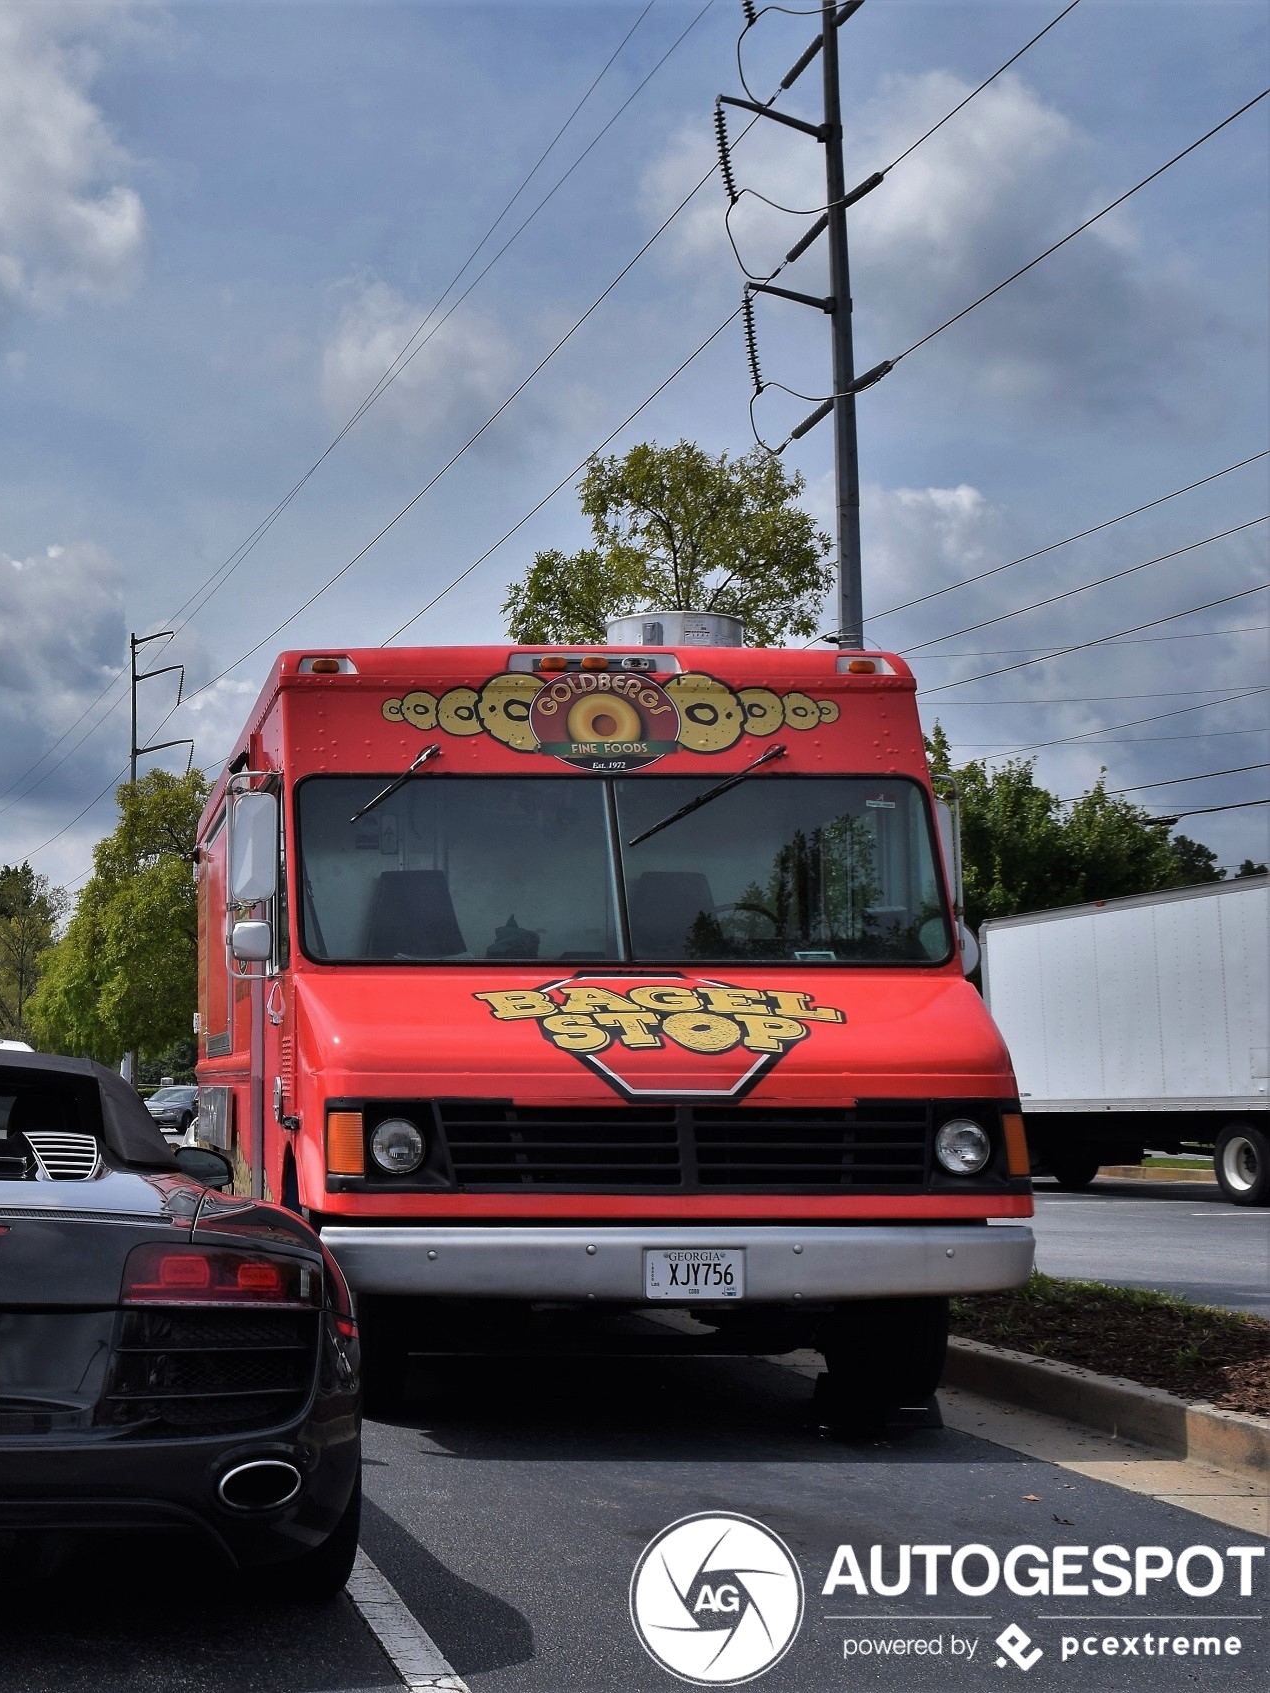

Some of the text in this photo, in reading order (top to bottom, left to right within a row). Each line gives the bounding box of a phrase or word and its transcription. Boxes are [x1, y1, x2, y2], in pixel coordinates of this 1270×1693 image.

[537, 673, 672, 715] GOLDBERGS
[571, 743, 648, 754] FINE FOODS
[592, 761, 626, 769] Est. 1972
[473, 986, 844, 1023] BAGEL
[542, 1011, 809, 1053] STOP
[669, 1251, 721, 1261] GEORGIA
[669, 1263, 734, 1286] XJY756
